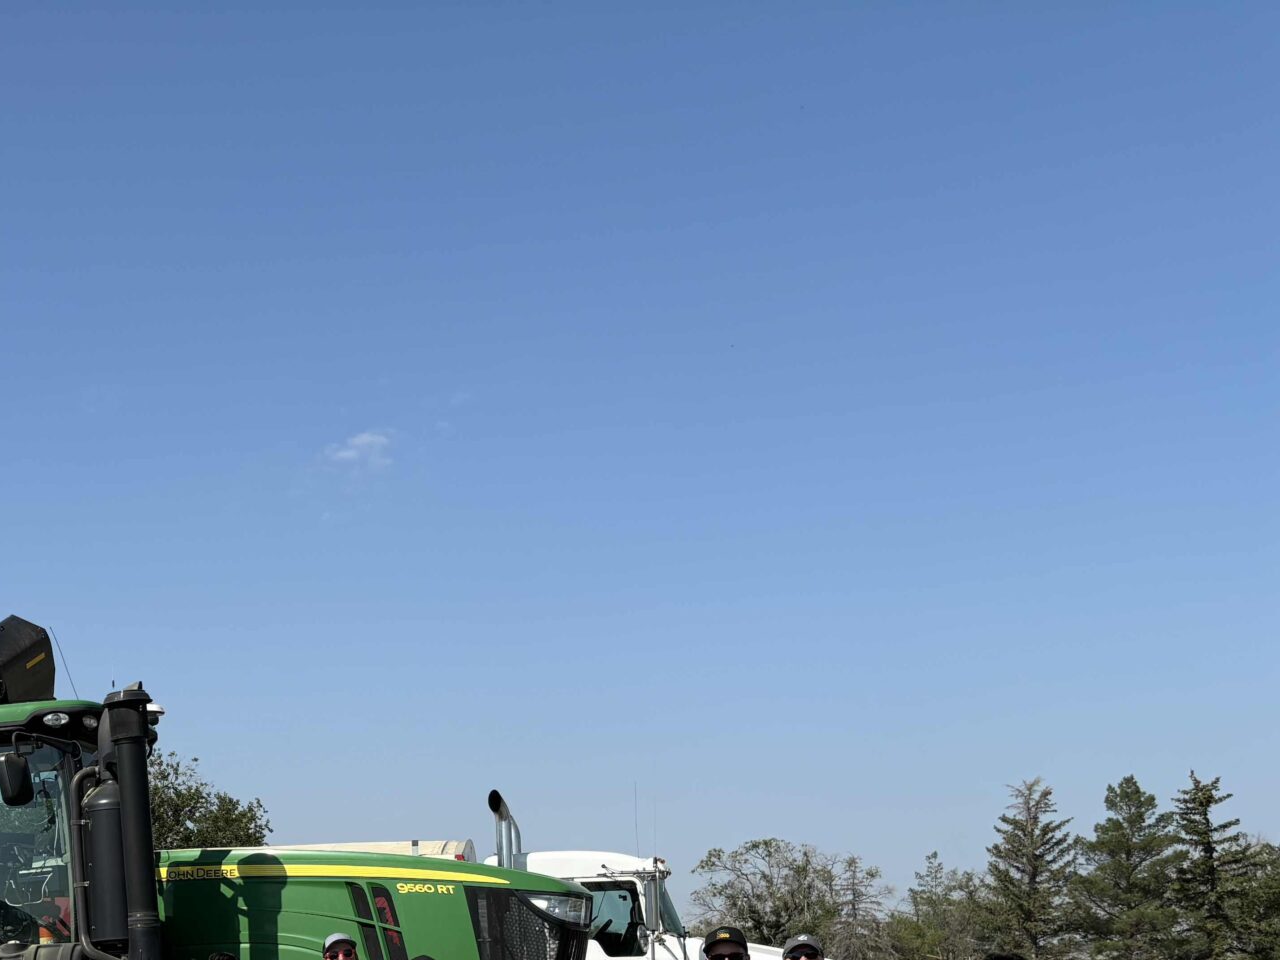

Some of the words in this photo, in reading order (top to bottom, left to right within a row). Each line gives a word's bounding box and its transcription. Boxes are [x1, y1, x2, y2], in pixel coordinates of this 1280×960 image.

[196, 868, 236, 878] DEERE
[396, 883, 435, 894] 9560
[436, 884, 456, 895] RT
